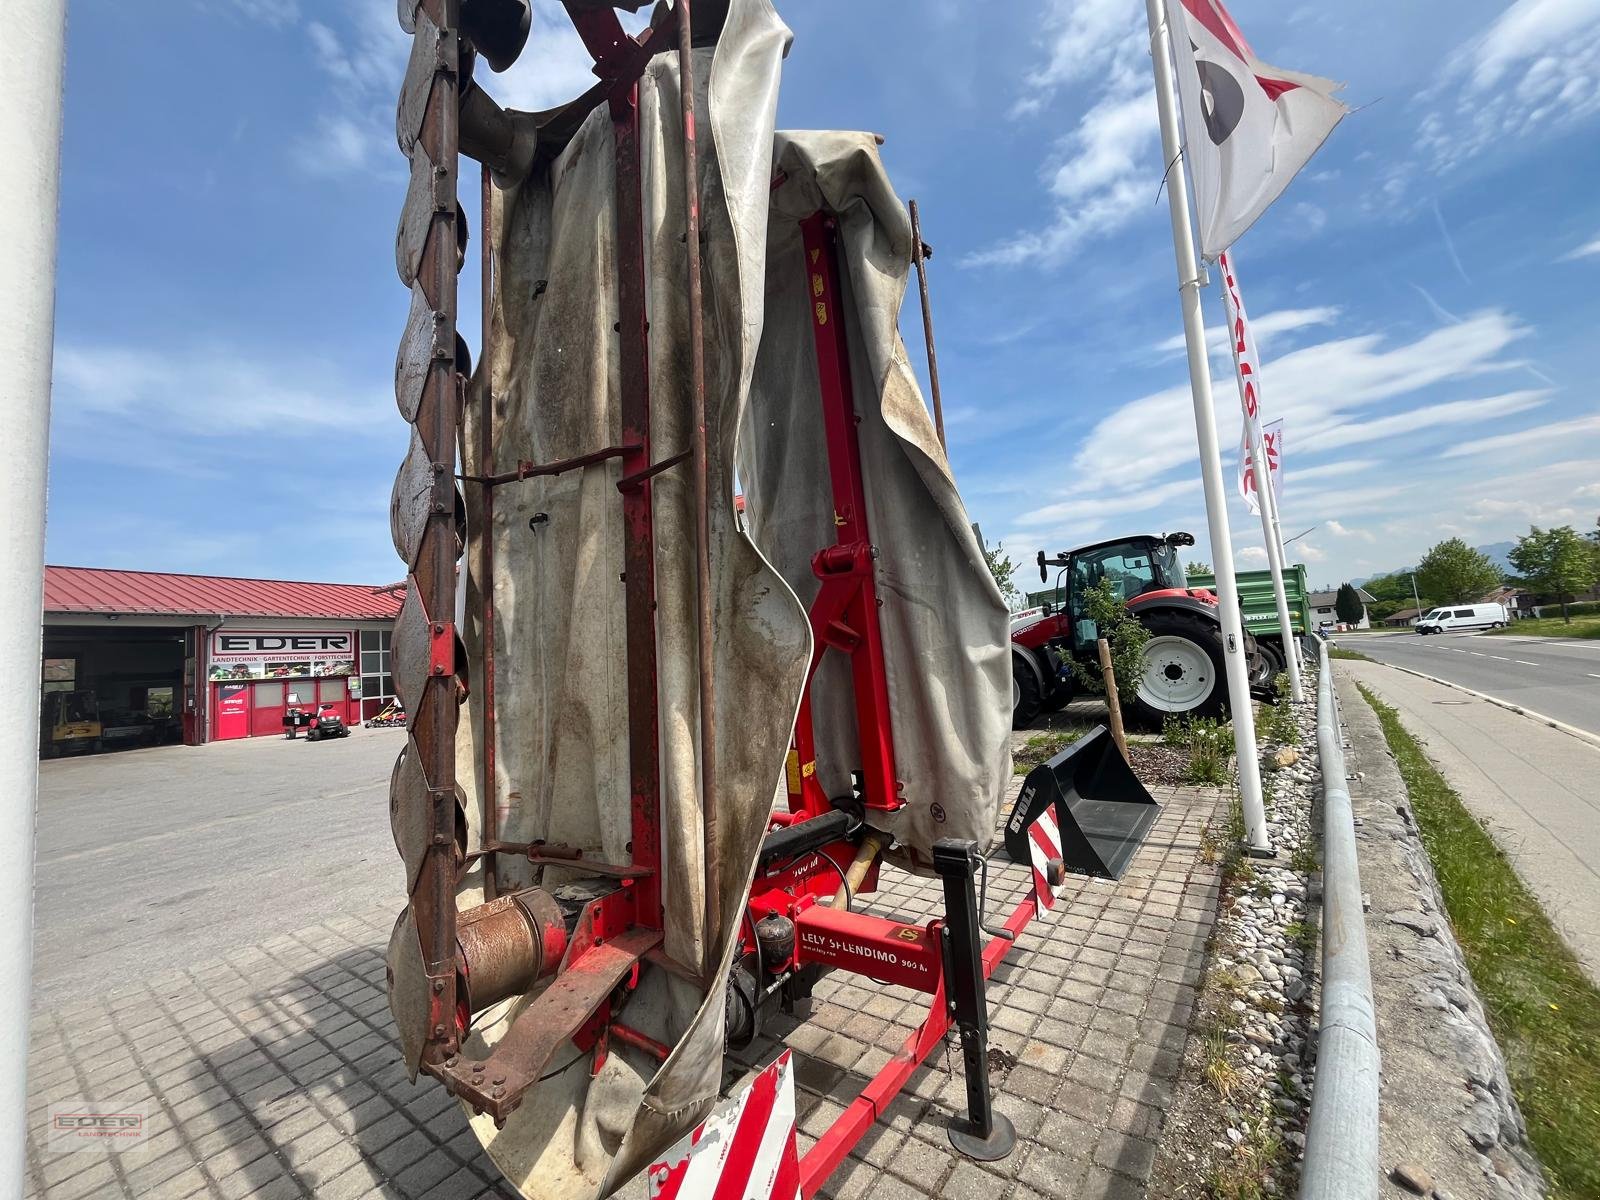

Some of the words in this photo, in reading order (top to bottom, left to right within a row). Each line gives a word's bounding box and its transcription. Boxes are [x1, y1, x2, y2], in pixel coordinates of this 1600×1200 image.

[219, 635, 348, 650] EDER
[1009, 785, 1037, 834] STOLL
[801, 932, 826, 945] LELY
